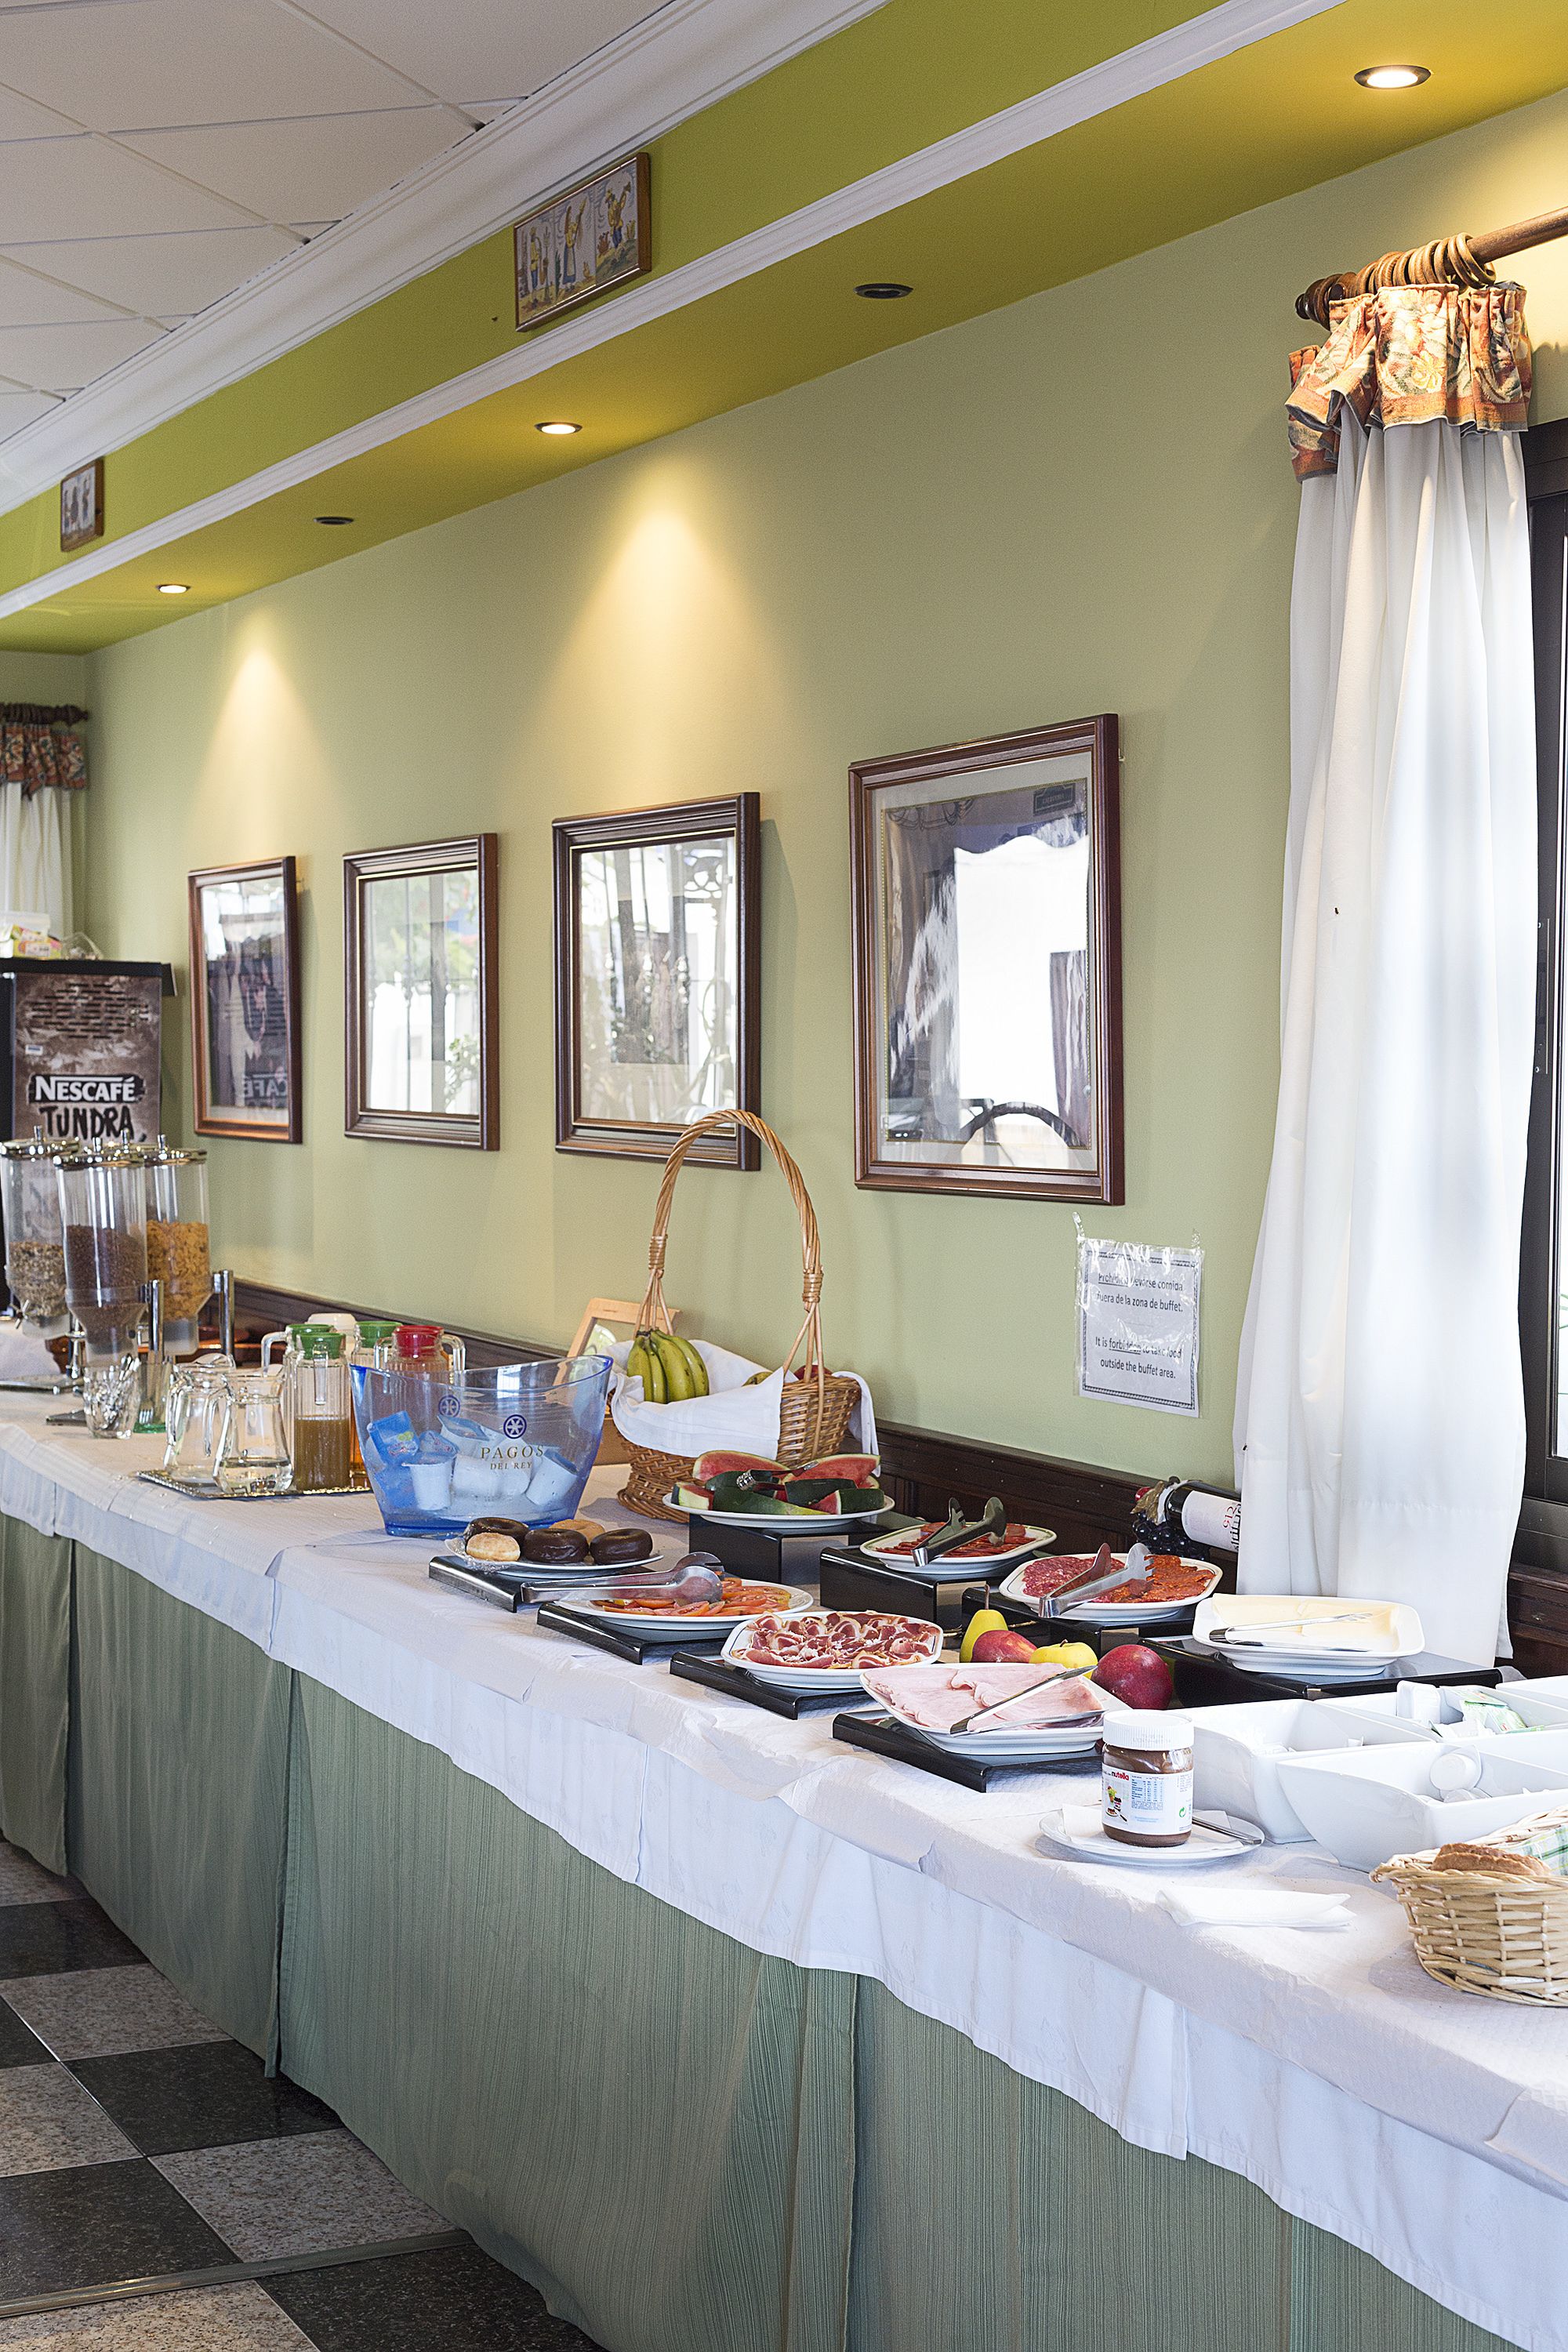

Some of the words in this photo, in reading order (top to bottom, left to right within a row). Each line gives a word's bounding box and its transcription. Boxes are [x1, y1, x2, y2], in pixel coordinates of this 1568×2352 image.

[34, 1076, 136, 1102] NESCAFÉ
[39, 1105, 134, 1141] TUNDRA
[1157, 1280, 1183, 1291] comida
[1116, 1293, 1123, 1305] de
[1124, 1294, 1131, 1305] la
[1132, 1298, 1148, 1308] zona
[1149, 1298, 1158, 1309] de
[1160, 1298, 1183, 1312] buffet.
[1095, 1337, 1101, 1346] It
[1102, 1337, 1108, 1348] is
[1100, 1359, 1124, 1370] outside
[1126, 1360, 1137, 1372] the
[1138, 1362, 1158, 1376] buffet
[1159, 1368, 1176, 1379] area.
[481, 1445, 543, 1459] PAGOS
[1112, 1772, 1129, 1780] nutella
